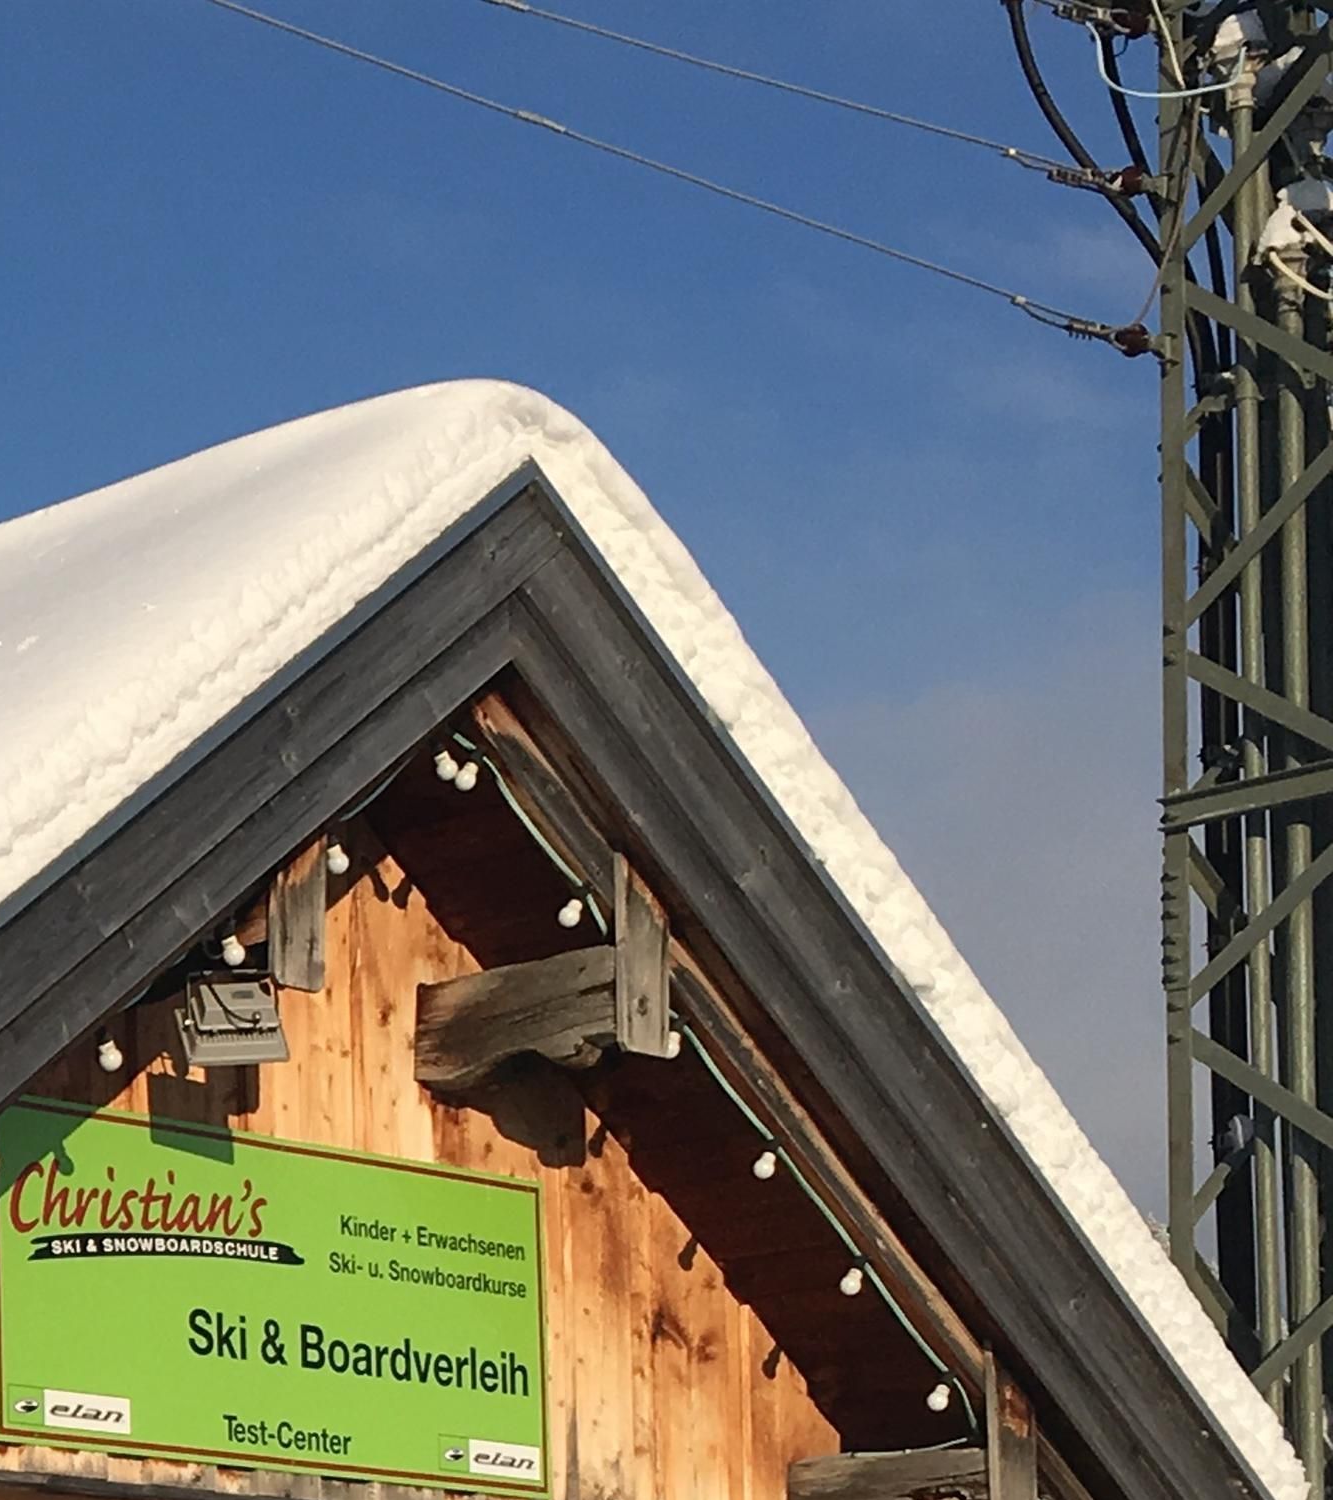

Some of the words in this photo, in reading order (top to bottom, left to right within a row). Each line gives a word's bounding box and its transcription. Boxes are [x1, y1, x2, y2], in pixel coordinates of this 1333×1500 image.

[9, 1159, 268, 1238] Christian's
[50, 1238, 83, 1256] SKI
[87, 1238, 97, 1252] &
[103, 1237, 279, 1261] SNOWBOARDSCHULE
[340, 1214, 397, 1245] Kinder
[401, 1230, 412, 1244] +
[417, 1226, 525, 1262] Erwachsenen
[329, 1252, 363, 1277] Ski-
[368, 1262, 384, 1280] u.
[389, 1260, 527, 1298] Snowboardkurse
[188, 1308, 247, 1360] Ski
[261, 1318, 287, 1366] &
[300, 1324, 529, 1397] Boardverleih
[49, 1402, 125, 1425] elan
[223, 1414, 352, 1456] Test-Center
[473, 1449, 536, 1472] elan
